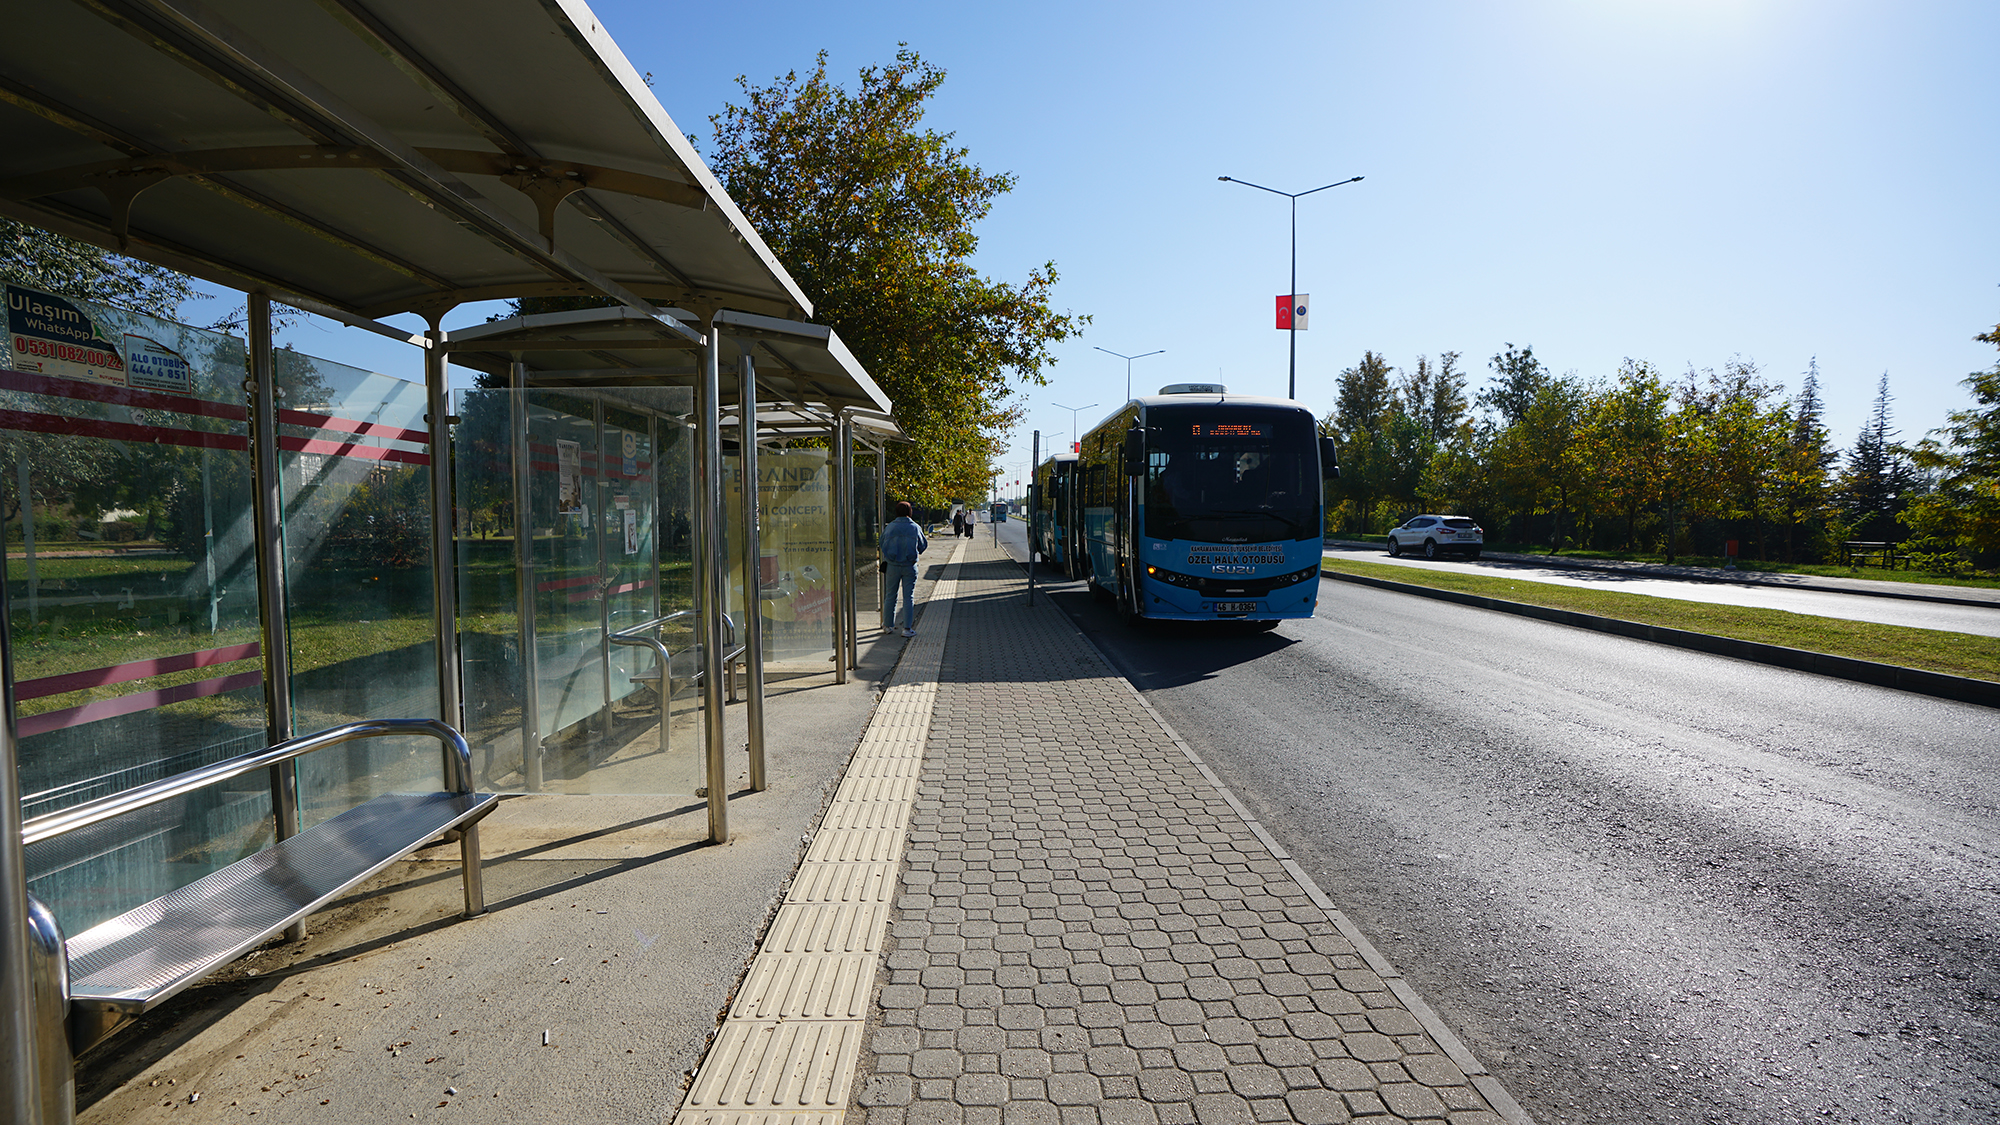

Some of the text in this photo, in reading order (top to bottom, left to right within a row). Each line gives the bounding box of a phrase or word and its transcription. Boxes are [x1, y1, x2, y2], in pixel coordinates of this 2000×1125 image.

[8, 292, 80, 324] Ulaşım
[24, 317, 90, 342] WhatsApp
[131, 352, 185, 370] ALO OTOBÜS
[131, 363, 154, 376] 444
[157, 367, 164, 377] 6
[167, 369, 186, 381] 851
[799, 482, 831, 493] Coffee
[771, 505, 826, 516] CONCEPT,
[1187, 553, 1286, 565] ÖZEL HALK OTOBÜSÜ
[1211, 565, 1256, 575] ISUZU
